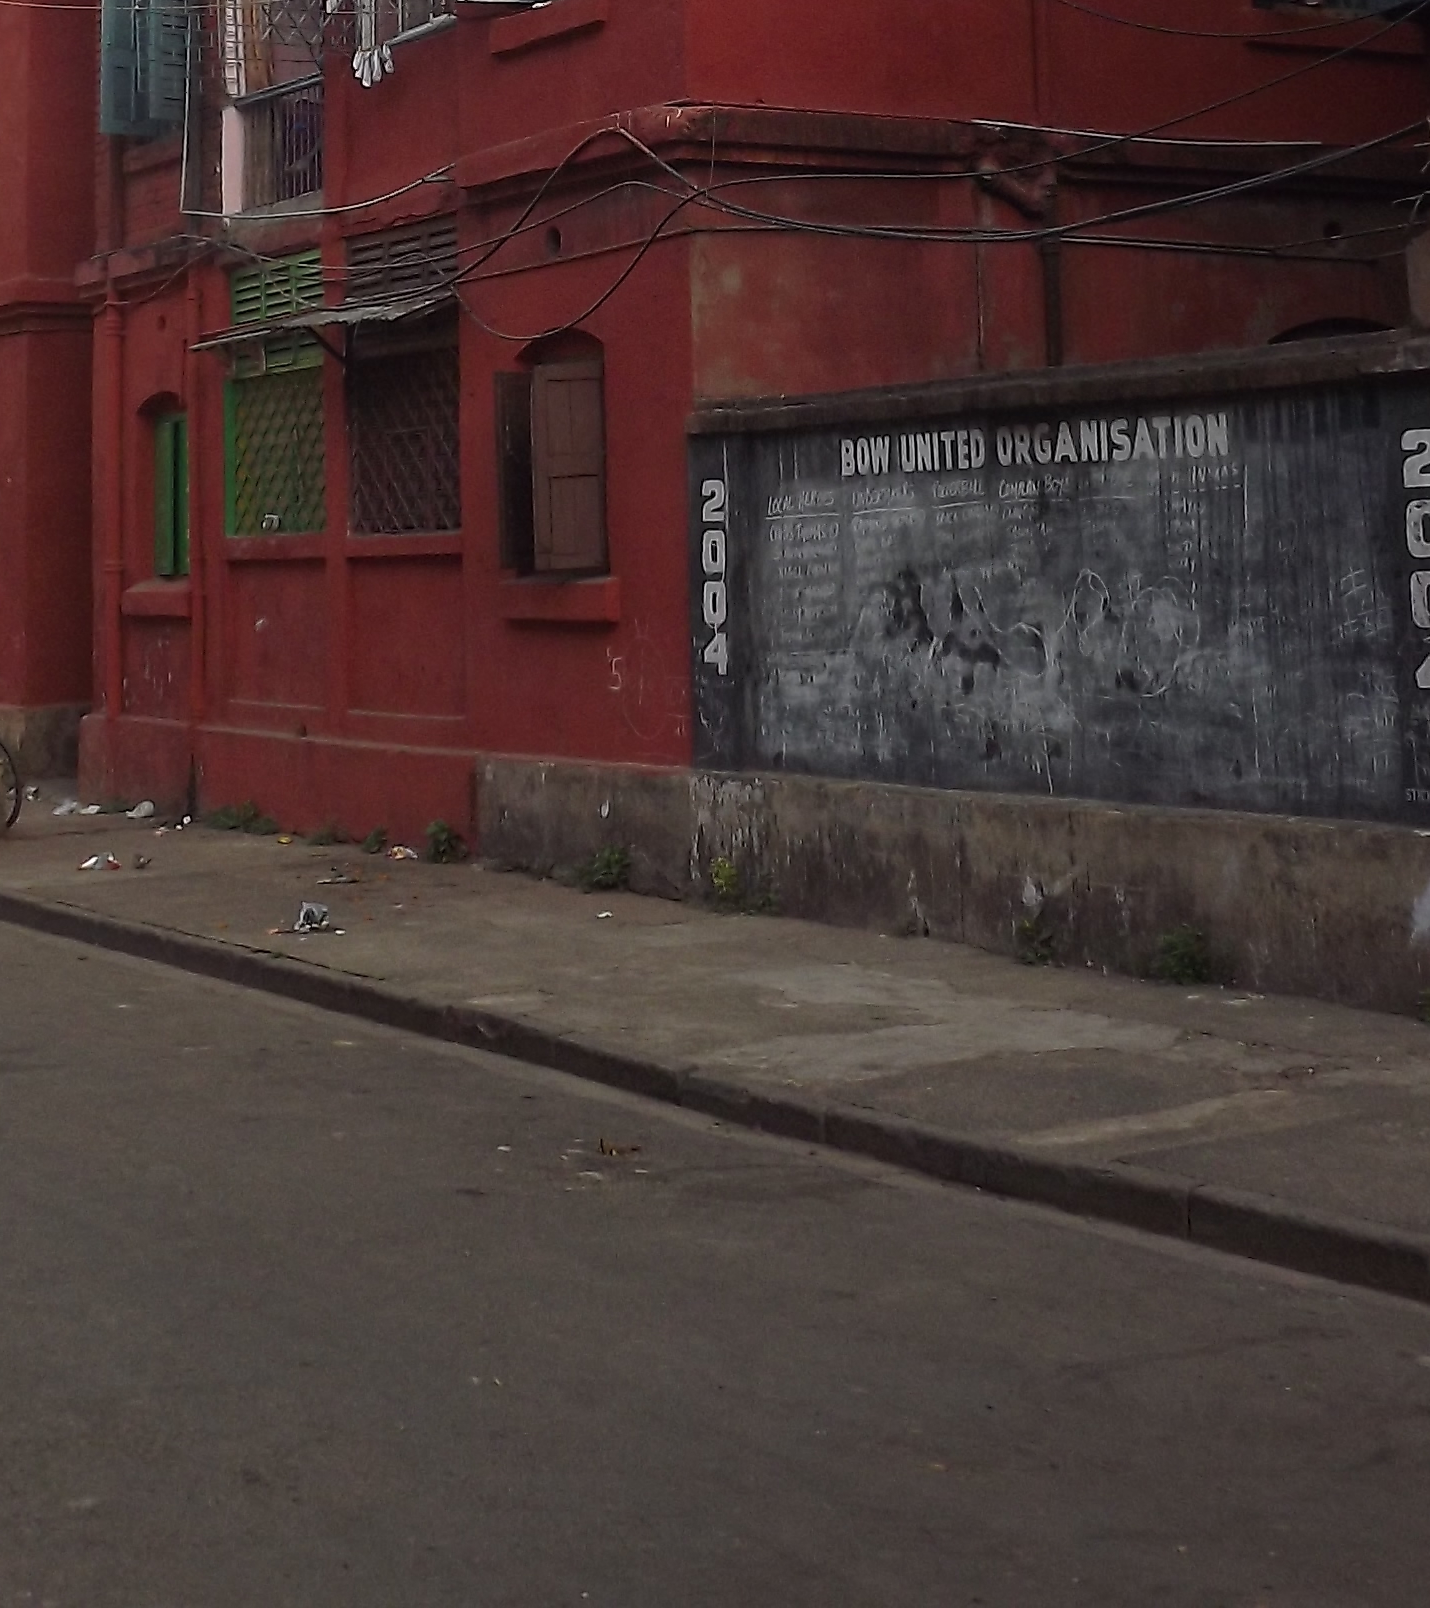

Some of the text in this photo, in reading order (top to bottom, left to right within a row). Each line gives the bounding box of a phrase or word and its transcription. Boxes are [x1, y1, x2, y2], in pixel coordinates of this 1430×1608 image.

[839, 412, 1231, 478] BOW UNITED ORGANISATION
[701, 479, 730, 676] 2004
